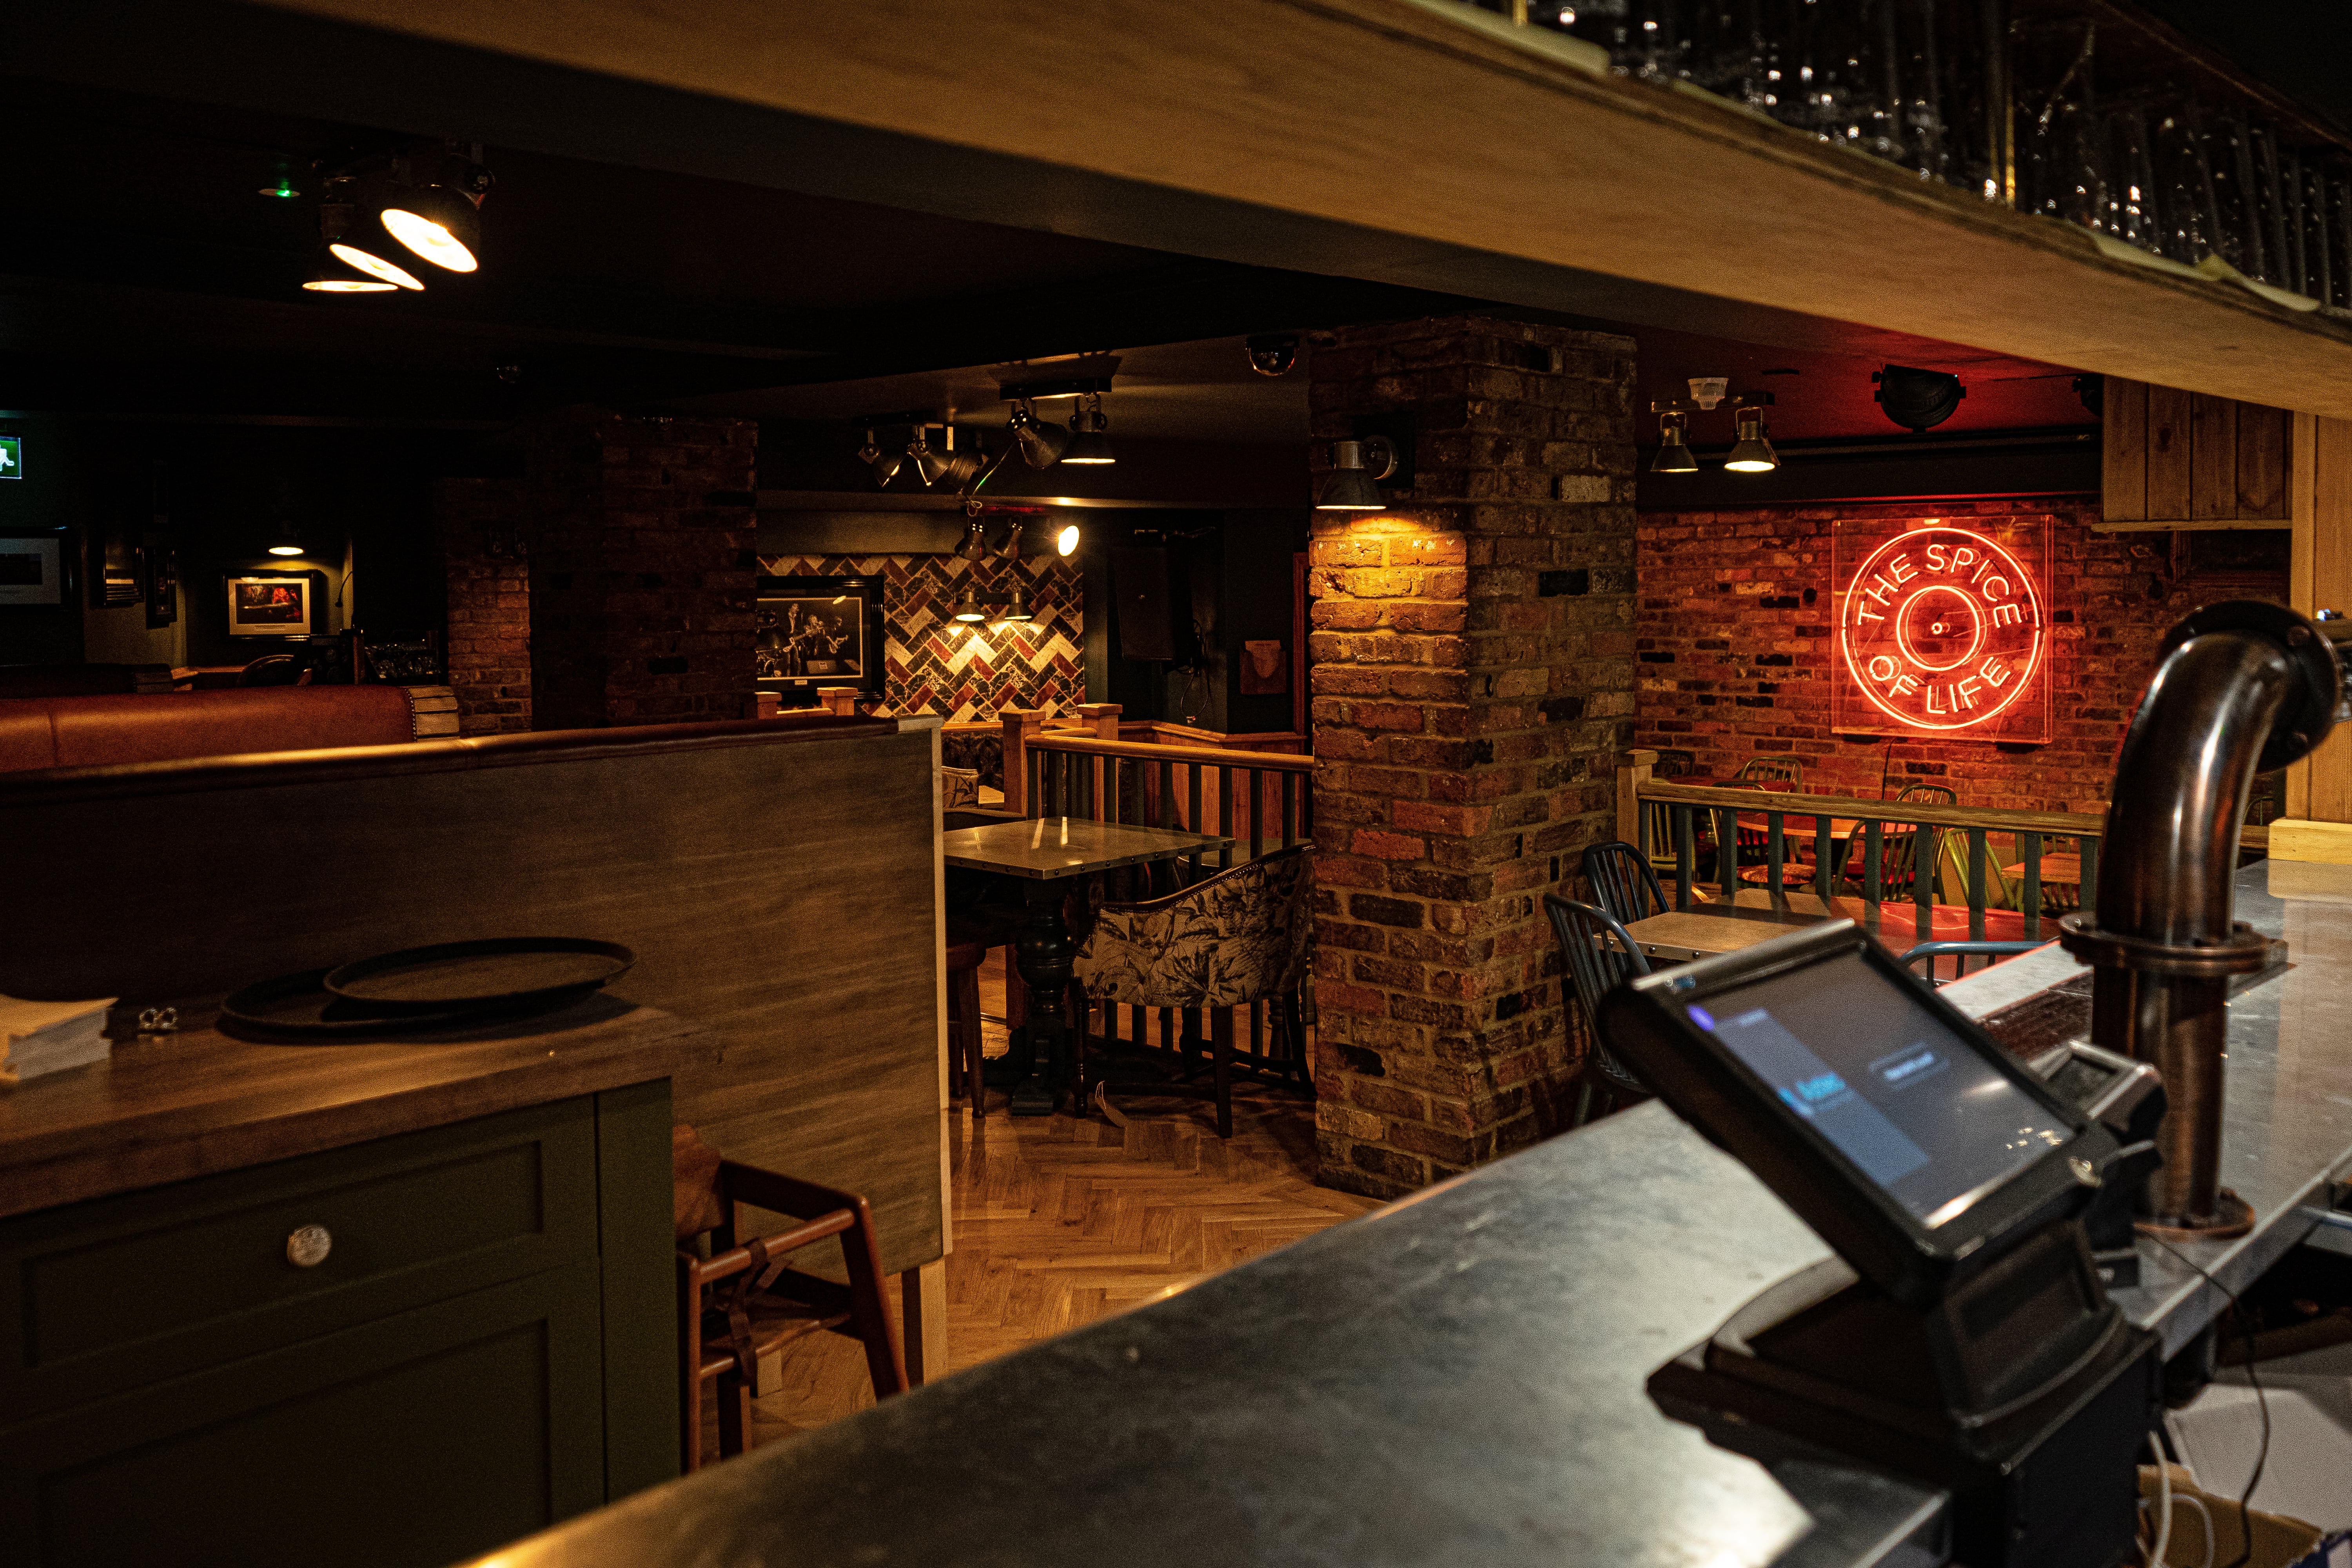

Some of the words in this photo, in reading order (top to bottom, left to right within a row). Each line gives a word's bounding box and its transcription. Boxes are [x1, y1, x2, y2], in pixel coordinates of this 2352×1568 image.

[1858, 554, 1918, 625] THE
[1926, 544, 2022, 628] SPICE
[1869, 655, 1918, 698] OF
[1927, 656, 2011, 714] LIFE
